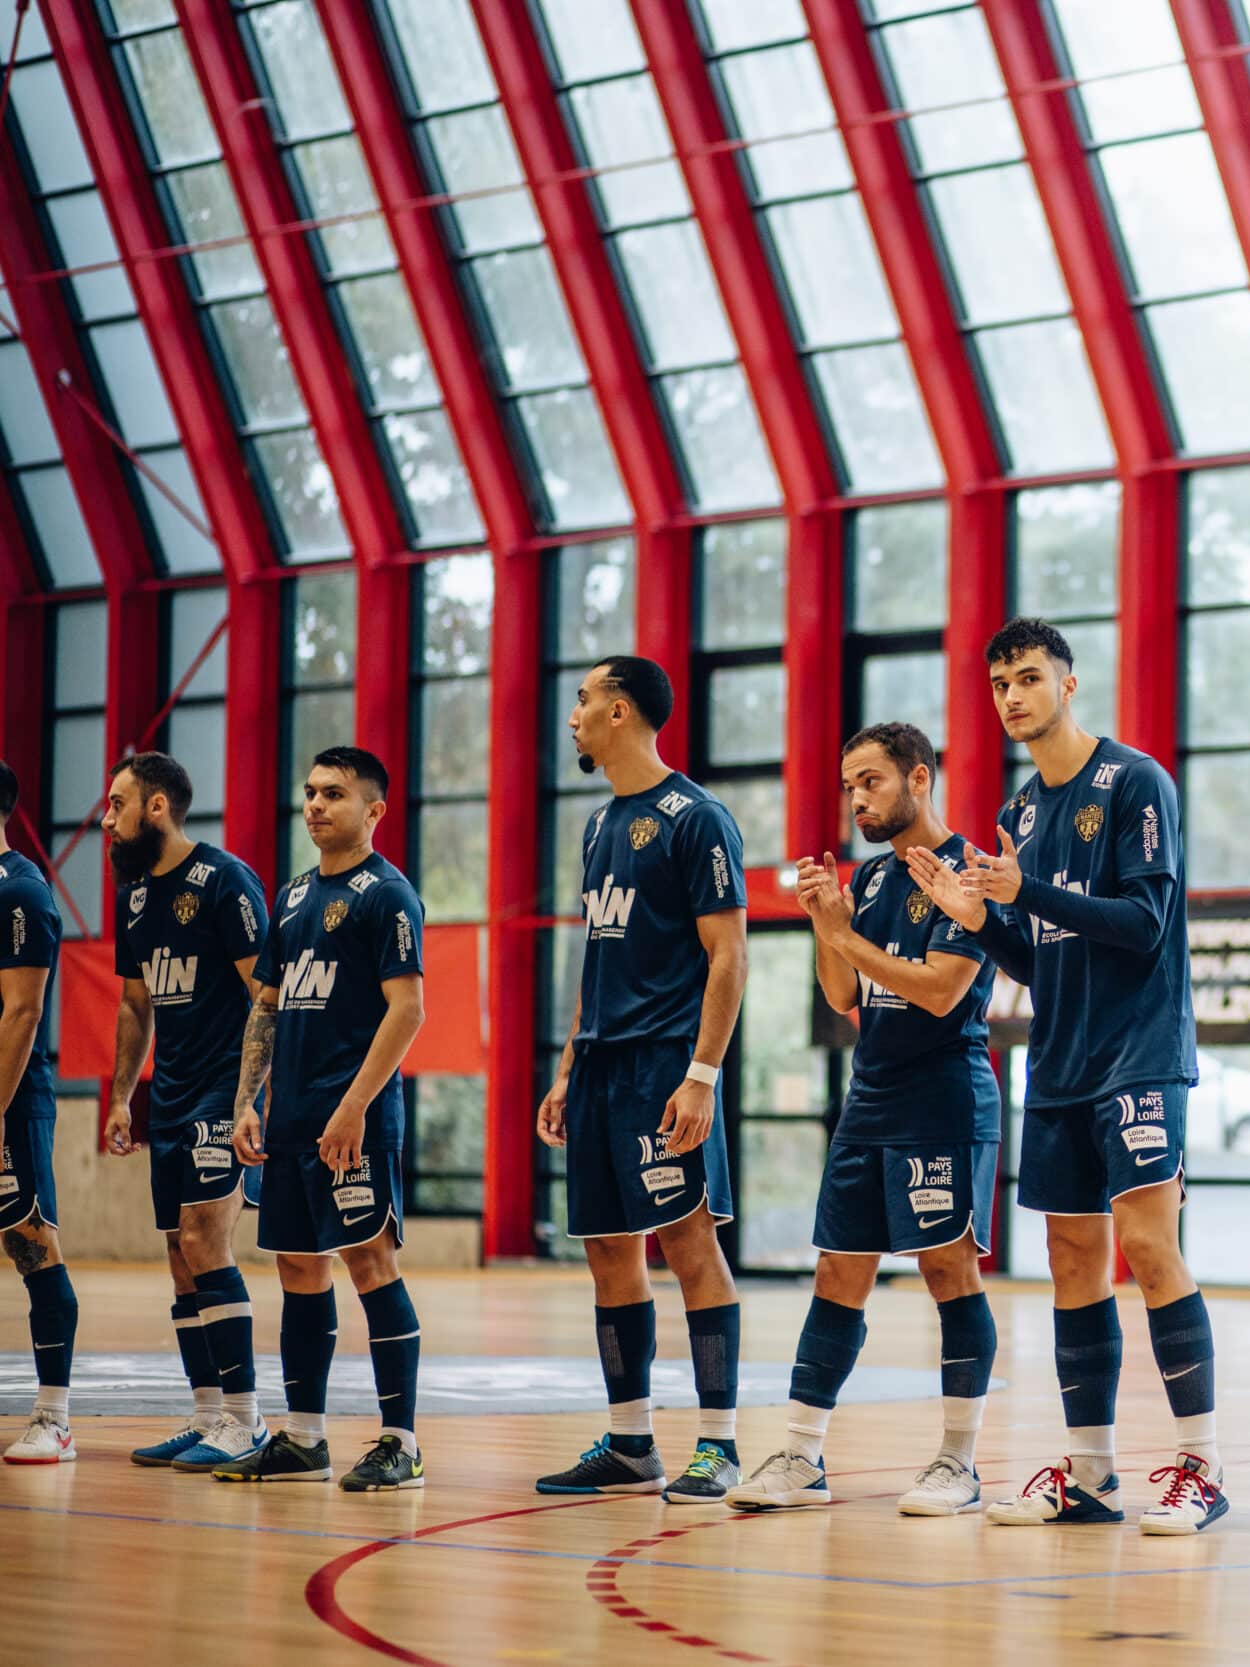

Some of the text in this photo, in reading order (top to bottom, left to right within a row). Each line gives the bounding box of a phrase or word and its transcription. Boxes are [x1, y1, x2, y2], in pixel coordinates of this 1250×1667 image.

[1139, 1097, 1163, 1107] PAYS
[1138, 1111, 1165, 1121] LOIRE
[928, 1162, 953, 1172] PAYS
[346, 1173, 372, 1184] LOIRE
[925, 1176, 953, 1186] LOIRE
